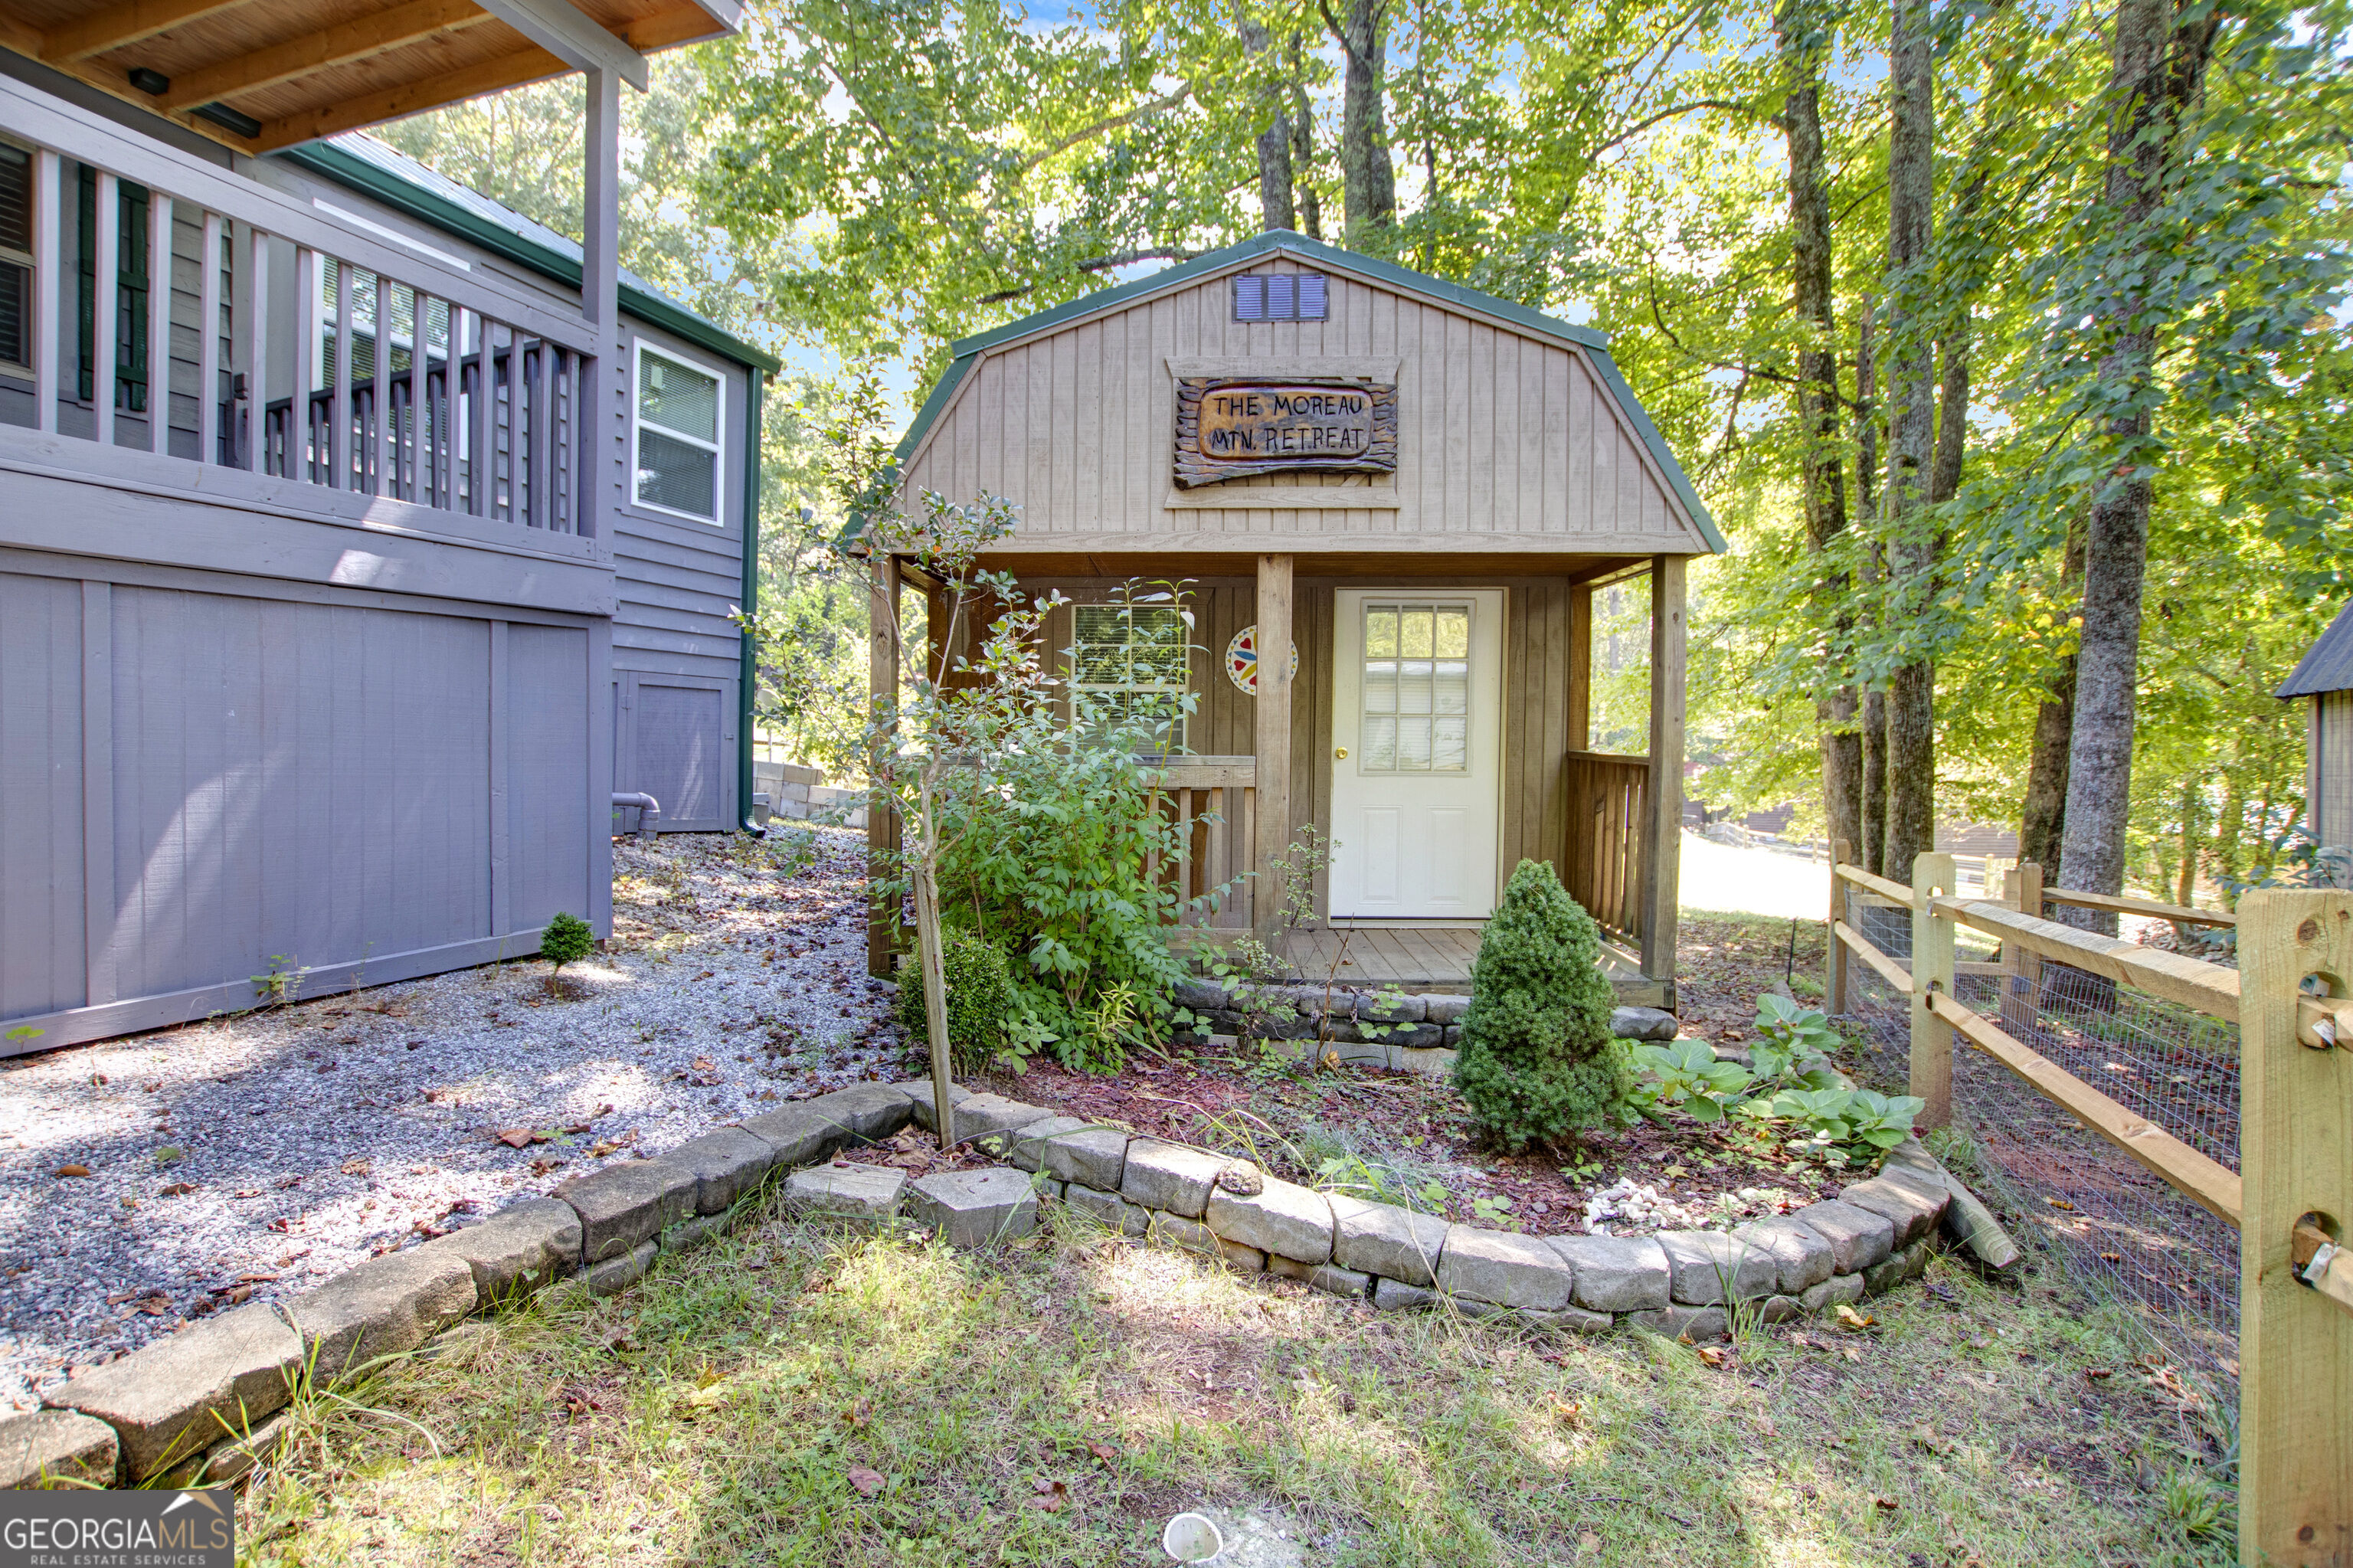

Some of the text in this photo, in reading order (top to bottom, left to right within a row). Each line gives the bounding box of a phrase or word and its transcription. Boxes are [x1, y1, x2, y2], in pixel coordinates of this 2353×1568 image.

[1213, 395, 1363, 417] THE MOREAU
[1212, 427, 1364, 450] MTN. RETREAT
